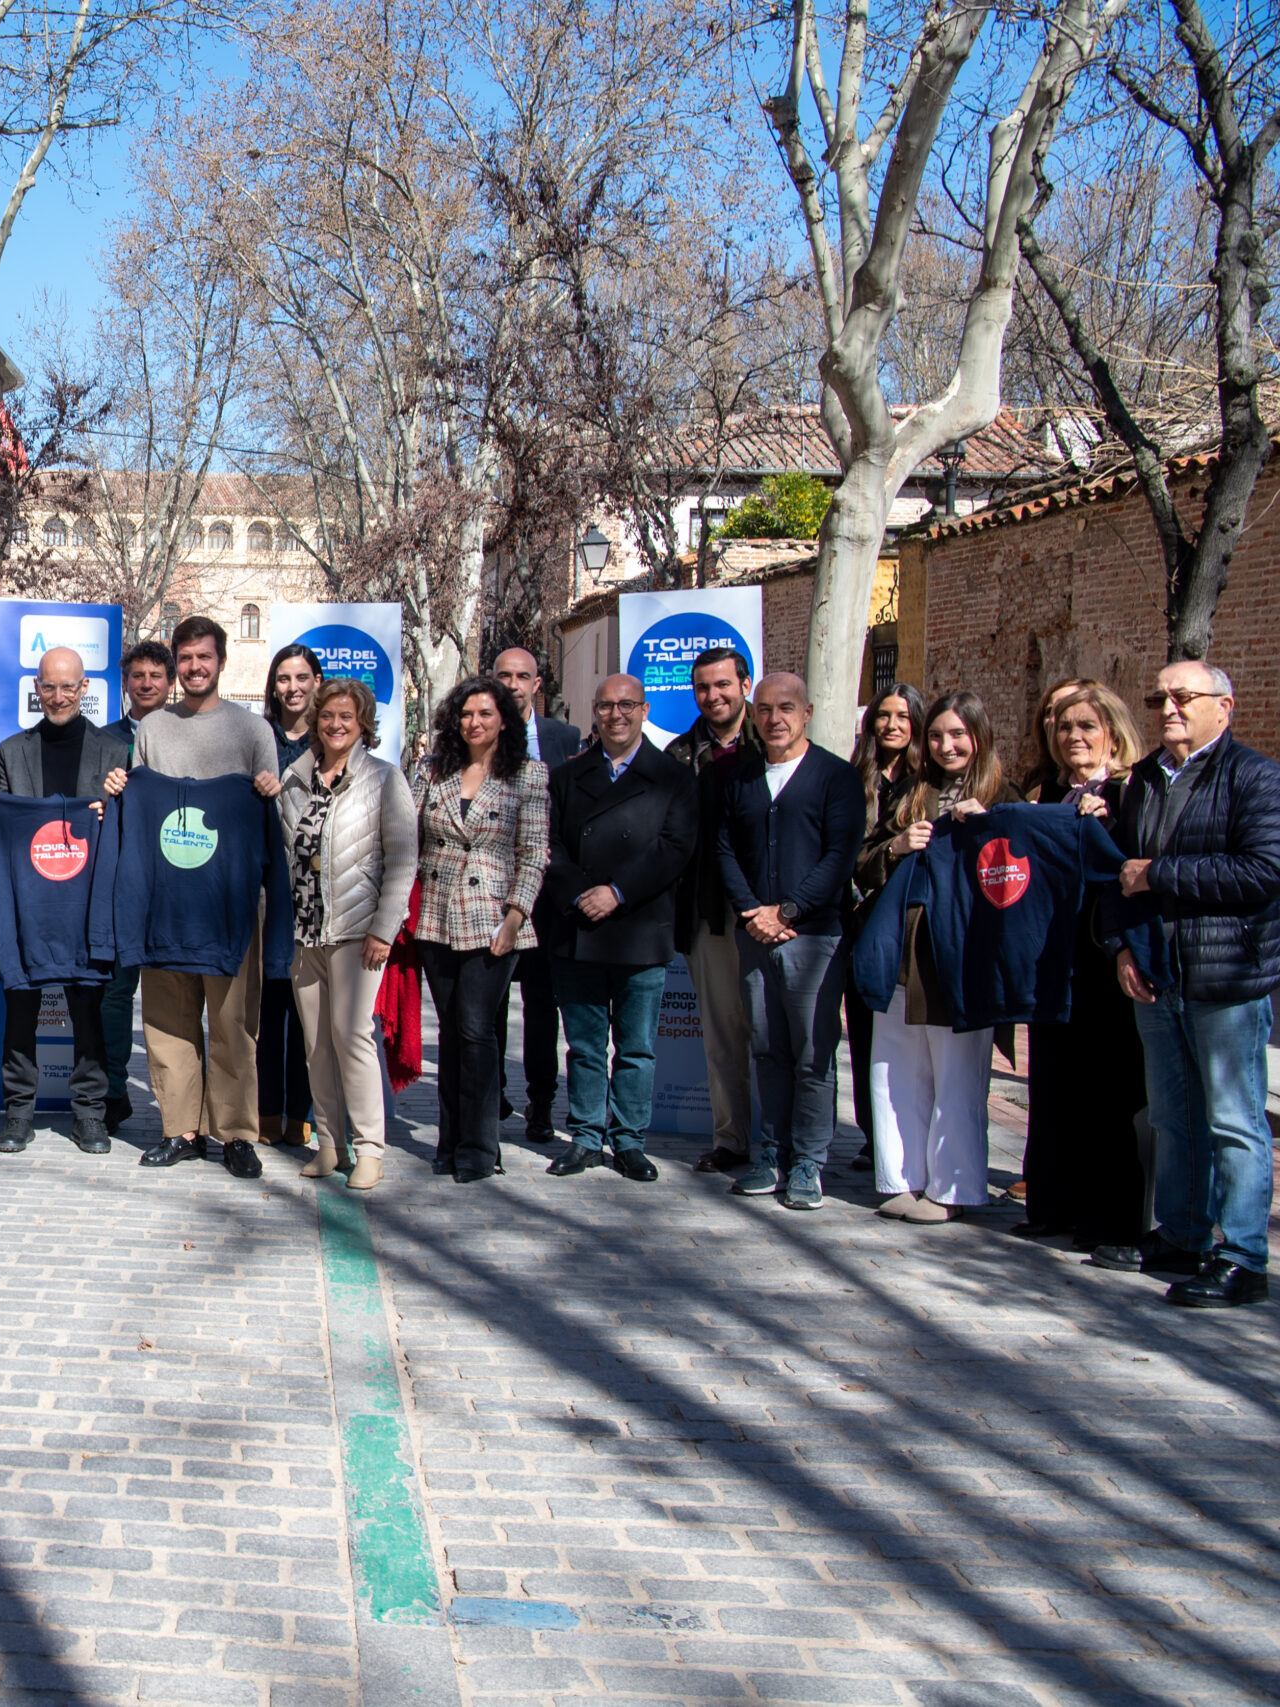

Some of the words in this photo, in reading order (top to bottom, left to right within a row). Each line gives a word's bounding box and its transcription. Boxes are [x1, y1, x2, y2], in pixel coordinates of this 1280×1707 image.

[643, 637, 707, 652] TOUR
[709, 637, 736, 650] DEL
[353, 650, 378, 660] DEL
[321, 660, 378, 671] LENTO
[644, 665, 693, 677] ALC
[164, 828, 195, 839] TOUR
[33, 843, 65, 853] TOUR
[163, 837, 214, 849] TALENTO
[33, 851, 85, 860] TALENTO
[1005, 864, 1020, 873] DEL
[658, 1013, 701, 1025] Funda
